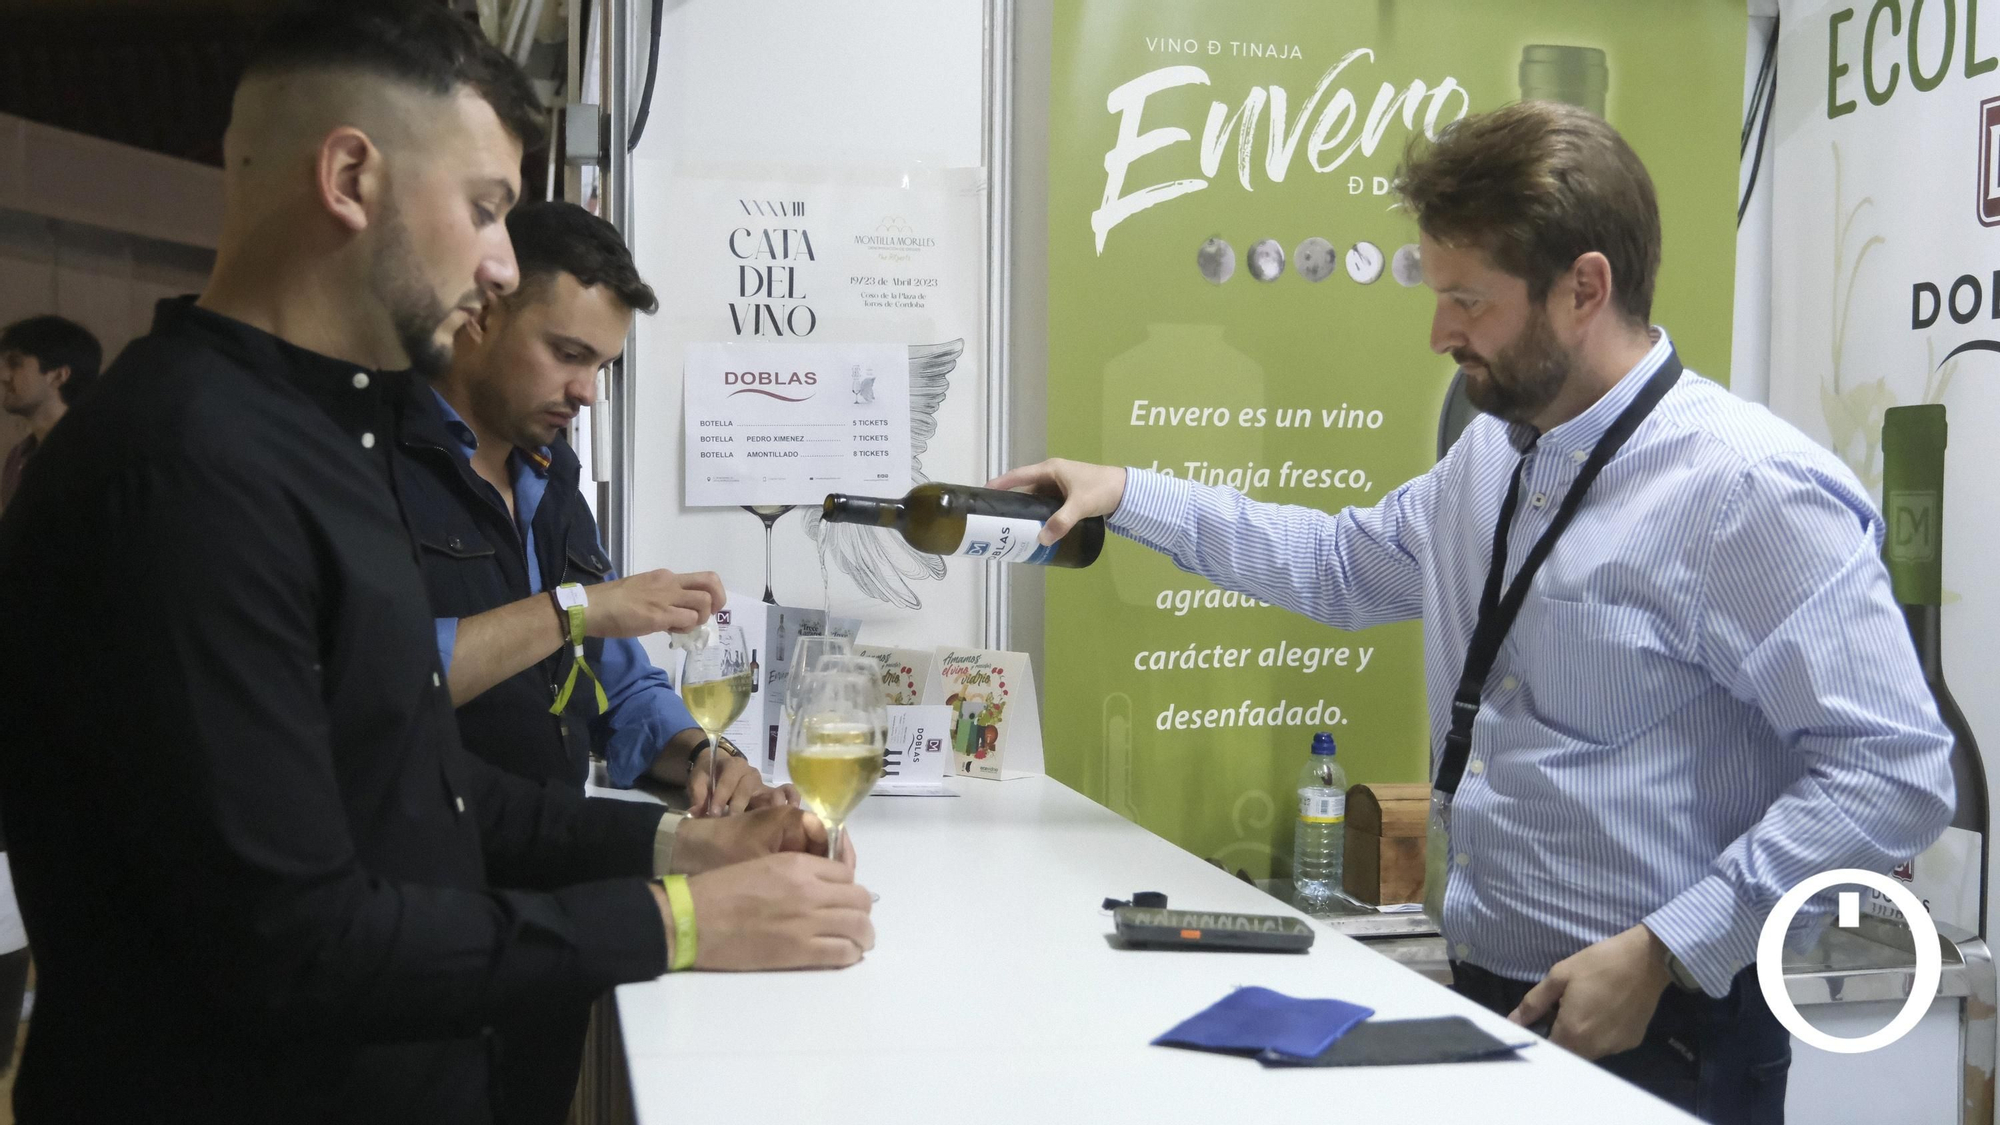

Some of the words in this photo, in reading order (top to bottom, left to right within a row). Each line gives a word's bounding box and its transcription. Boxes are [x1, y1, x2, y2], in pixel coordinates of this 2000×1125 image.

[1145, 37, 1198, 54] VINO
[1230, 41, 1302, 60] TINAJA
[1091, 47, 1470, 257] Envero
[739, 199, 805, 217] XXXVIII
[728, 227, 816, 262] CATA
[854, 235, 895, 246] MONTILLA
[739, 265, 807, 299] DEL
[850, 276, 876, 286] 19/23
[877, 277, 889, 286] de
[892, 277, 912, 286] Abril
[913, 278, 938, 287] 2023
[860, 291, 879, 299] Coso
[898, 292, 916, 300] Plaza
[728, 302, 817, 338] VINO
[724, 371, 818, 386] DOBLAS
[1130, 400, 1230, 428] Envero
[1238, 406, 1267, 428] es
[1275, 406, 1312, 428] un
[1321, 402, 1384, 429] vino
[747, 450, 799, 458] AMONTILLADO
[1183, 461, 1270, 494] Tinaja
[1279, 461, 1373, 492] fresco,
[943, 651, 982, 666] Amamos
[1134, 643, 1251, 671] carácter
[1258, 640, 1349, 673] alegre
[1355, 647, 1374, 673] y
[961, 669, 991, 687] vidrio
[1156, 700, 1348, 731] desenfadado.
[912, 727, 925, 764] DOBLAS
